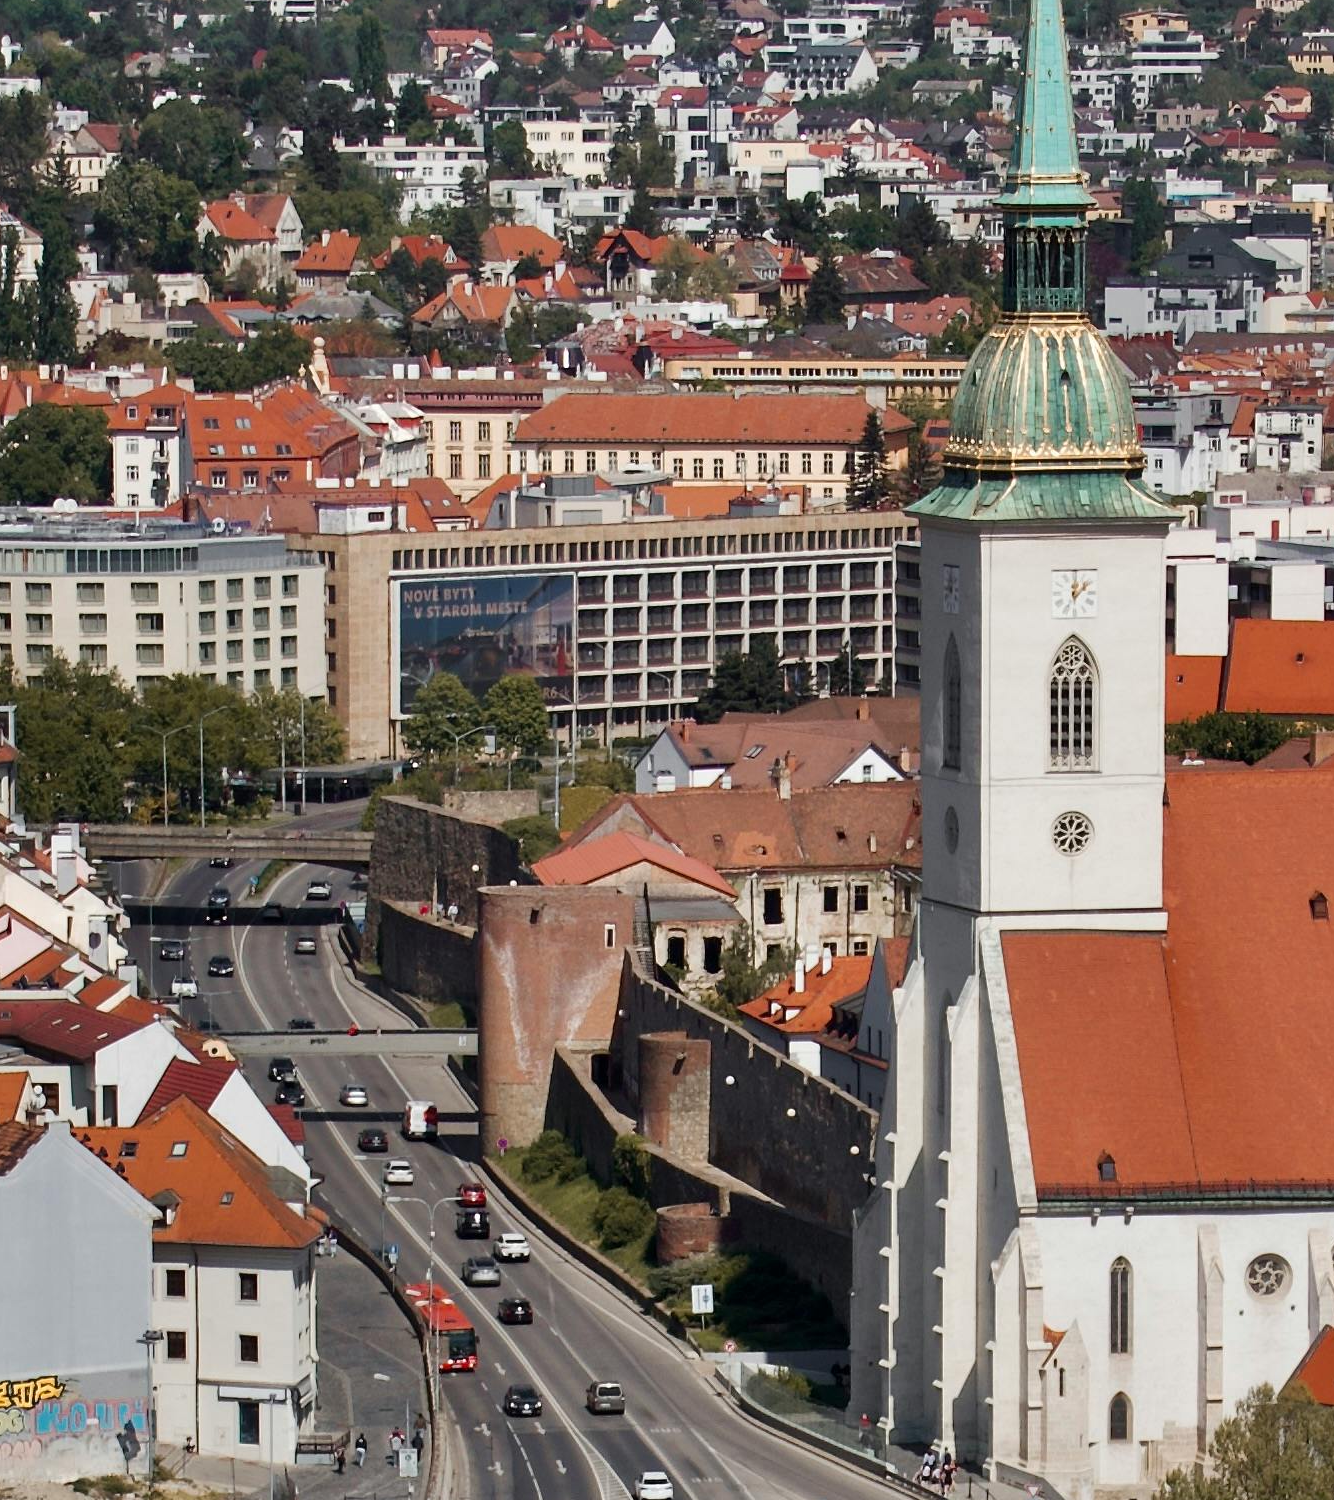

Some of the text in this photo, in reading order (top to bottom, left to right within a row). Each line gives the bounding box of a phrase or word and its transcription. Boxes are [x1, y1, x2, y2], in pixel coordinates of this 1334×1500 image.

[403, 585, 476, 603] NOVÉ BYTY
[413, 601, 527, 619] V STAROM MESTE
